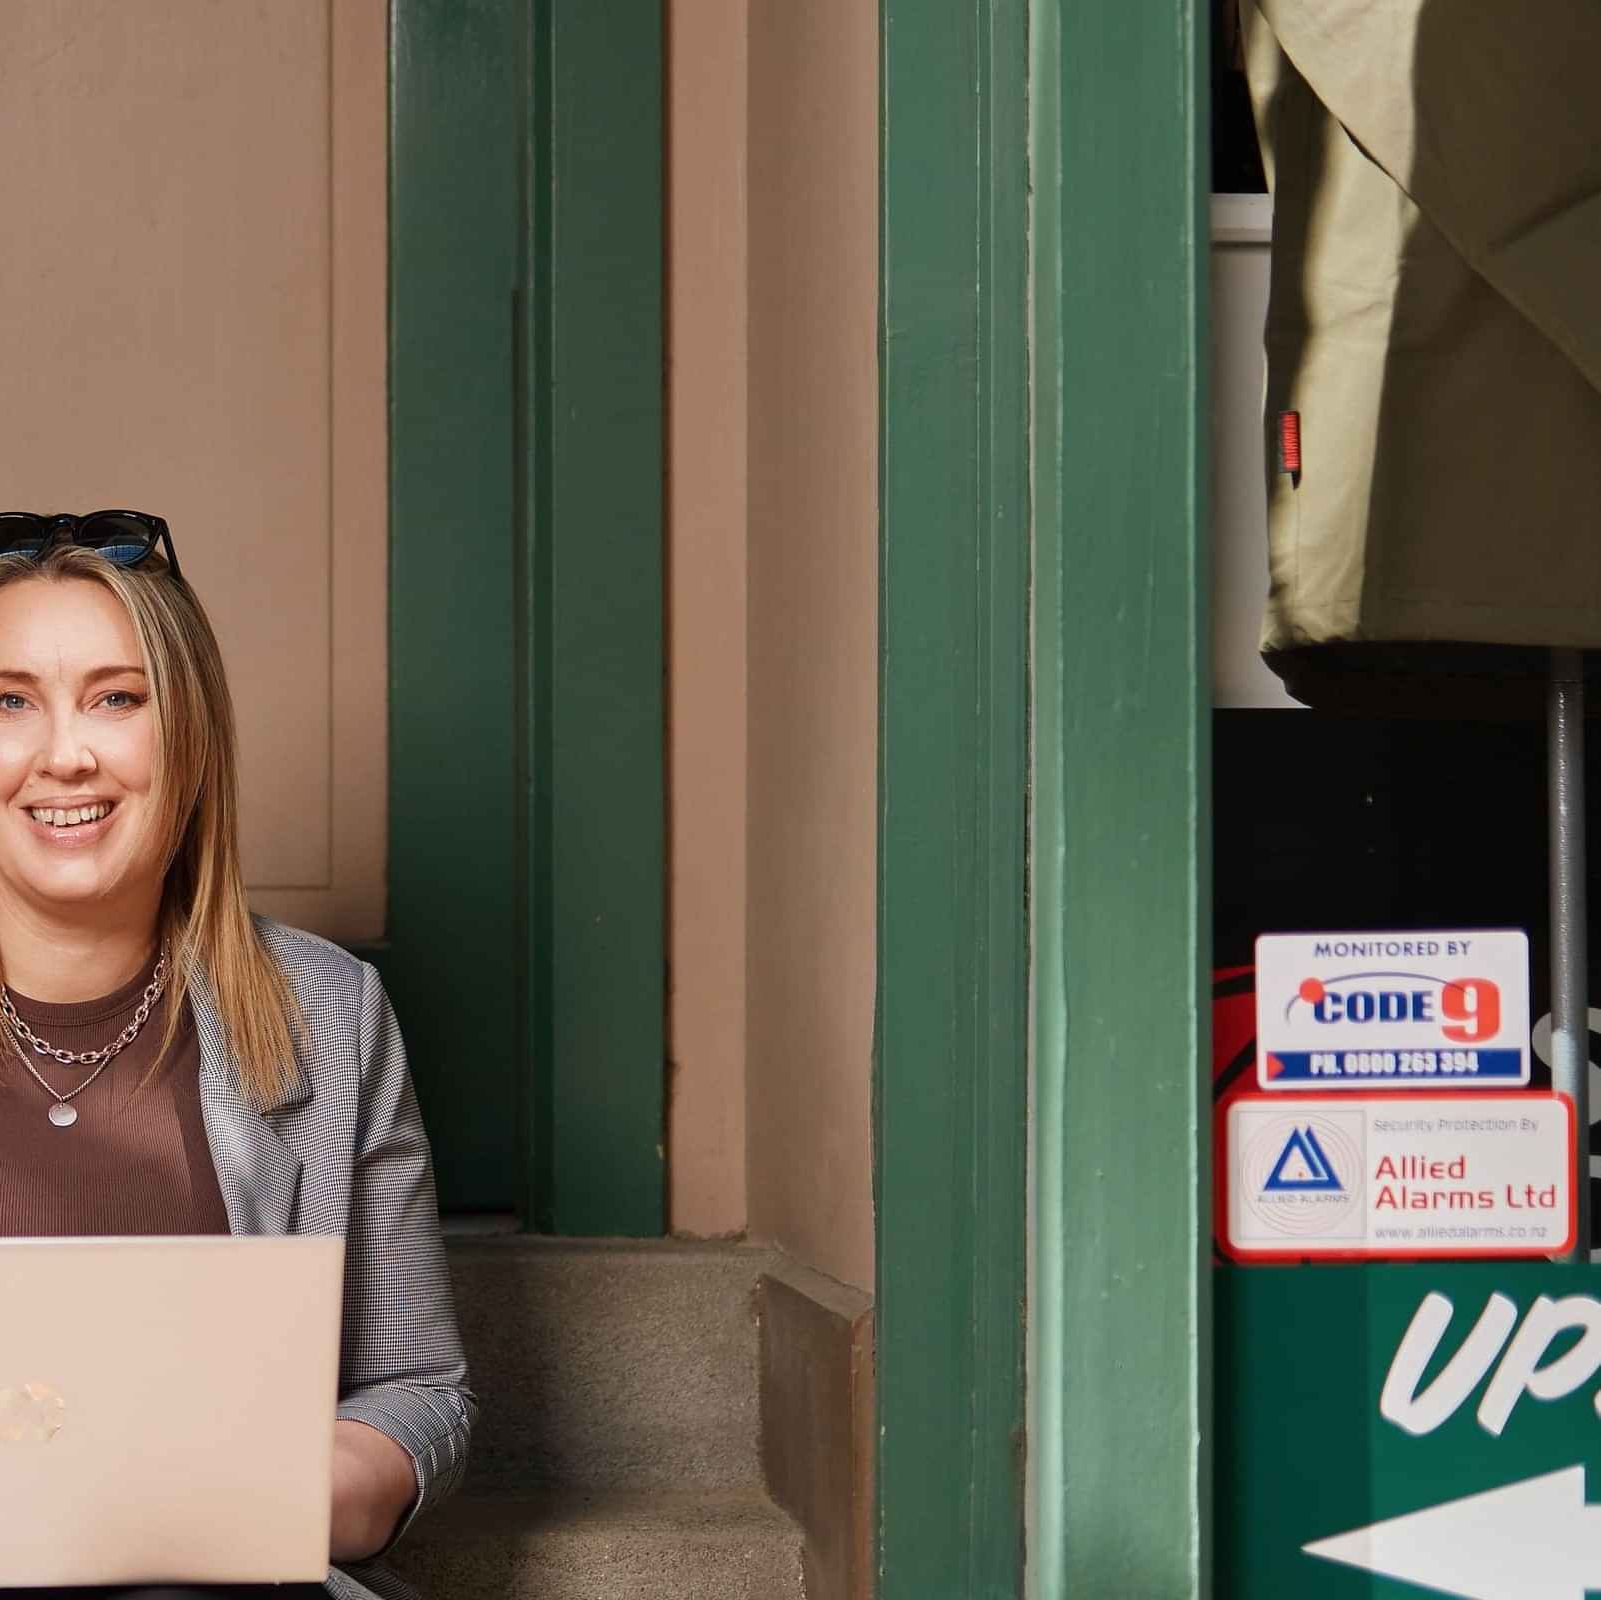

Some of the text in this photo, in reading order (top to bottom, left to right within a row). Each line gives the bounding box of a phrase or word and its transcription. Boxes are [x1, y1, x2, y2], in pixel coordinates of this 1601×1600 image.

[1314, 940, 1472, 958] MONITORED BY
[1313, 977, 1501, 1044] CODE 9
[1344, 1052, 1396, 1074] 0800
[1373, 1118, 1434, 1133] Security
[1437, 1117, 1517, 1132] Protection
[1375, 1154, 1467, 1180] Allied
[1375, 1183, 1558, 1210] Alarms Ltd
[1379, 1289, 1601, 1439] UP
